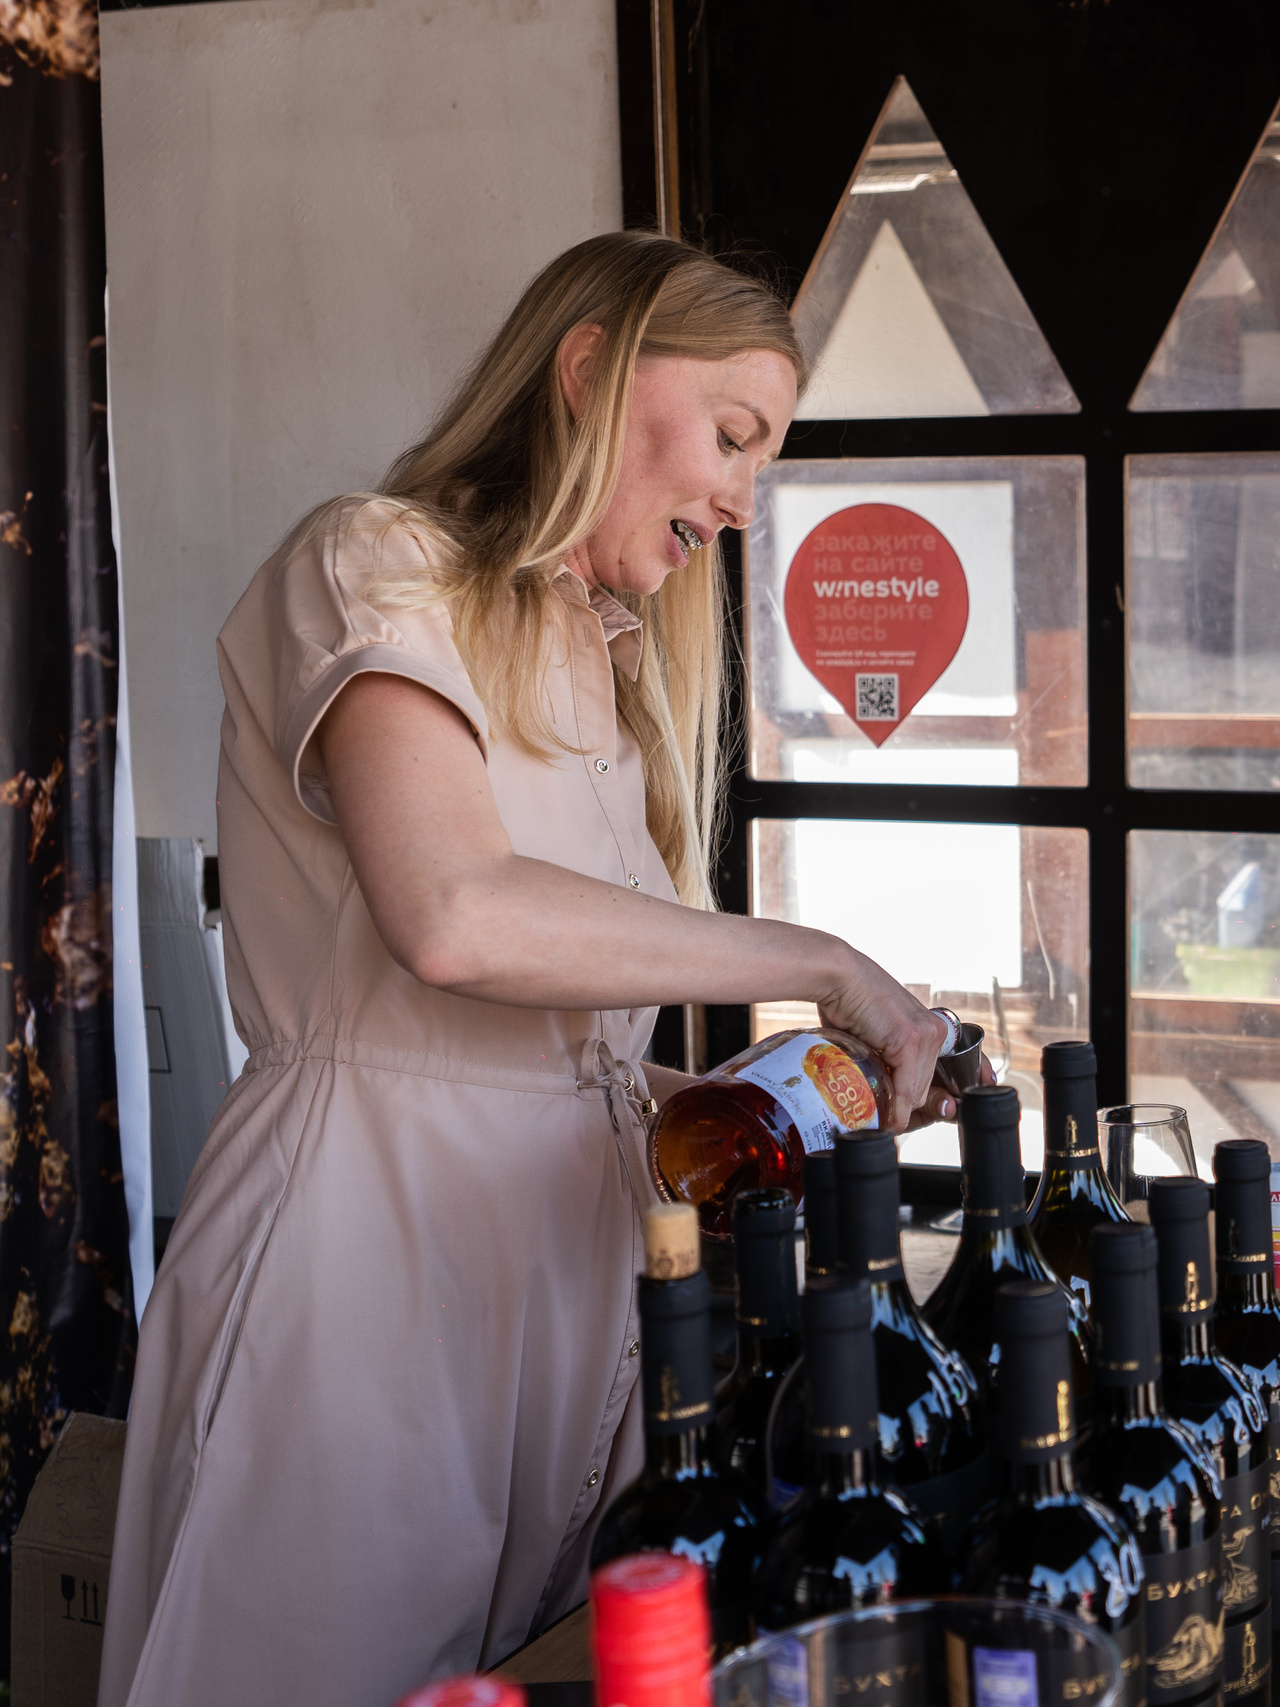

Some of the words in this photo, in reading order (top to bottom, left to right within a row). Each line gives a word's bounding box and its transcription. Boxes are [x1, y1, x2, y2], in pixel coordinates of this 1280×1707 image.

[814, 534, 936, 551] закажите
[814, 556, 843, 573] на
[815, 599, 932, 624] заберите
[815, 625, 887, 645] здесь
[1147, 1567, 1217, 1601] БУХТА
